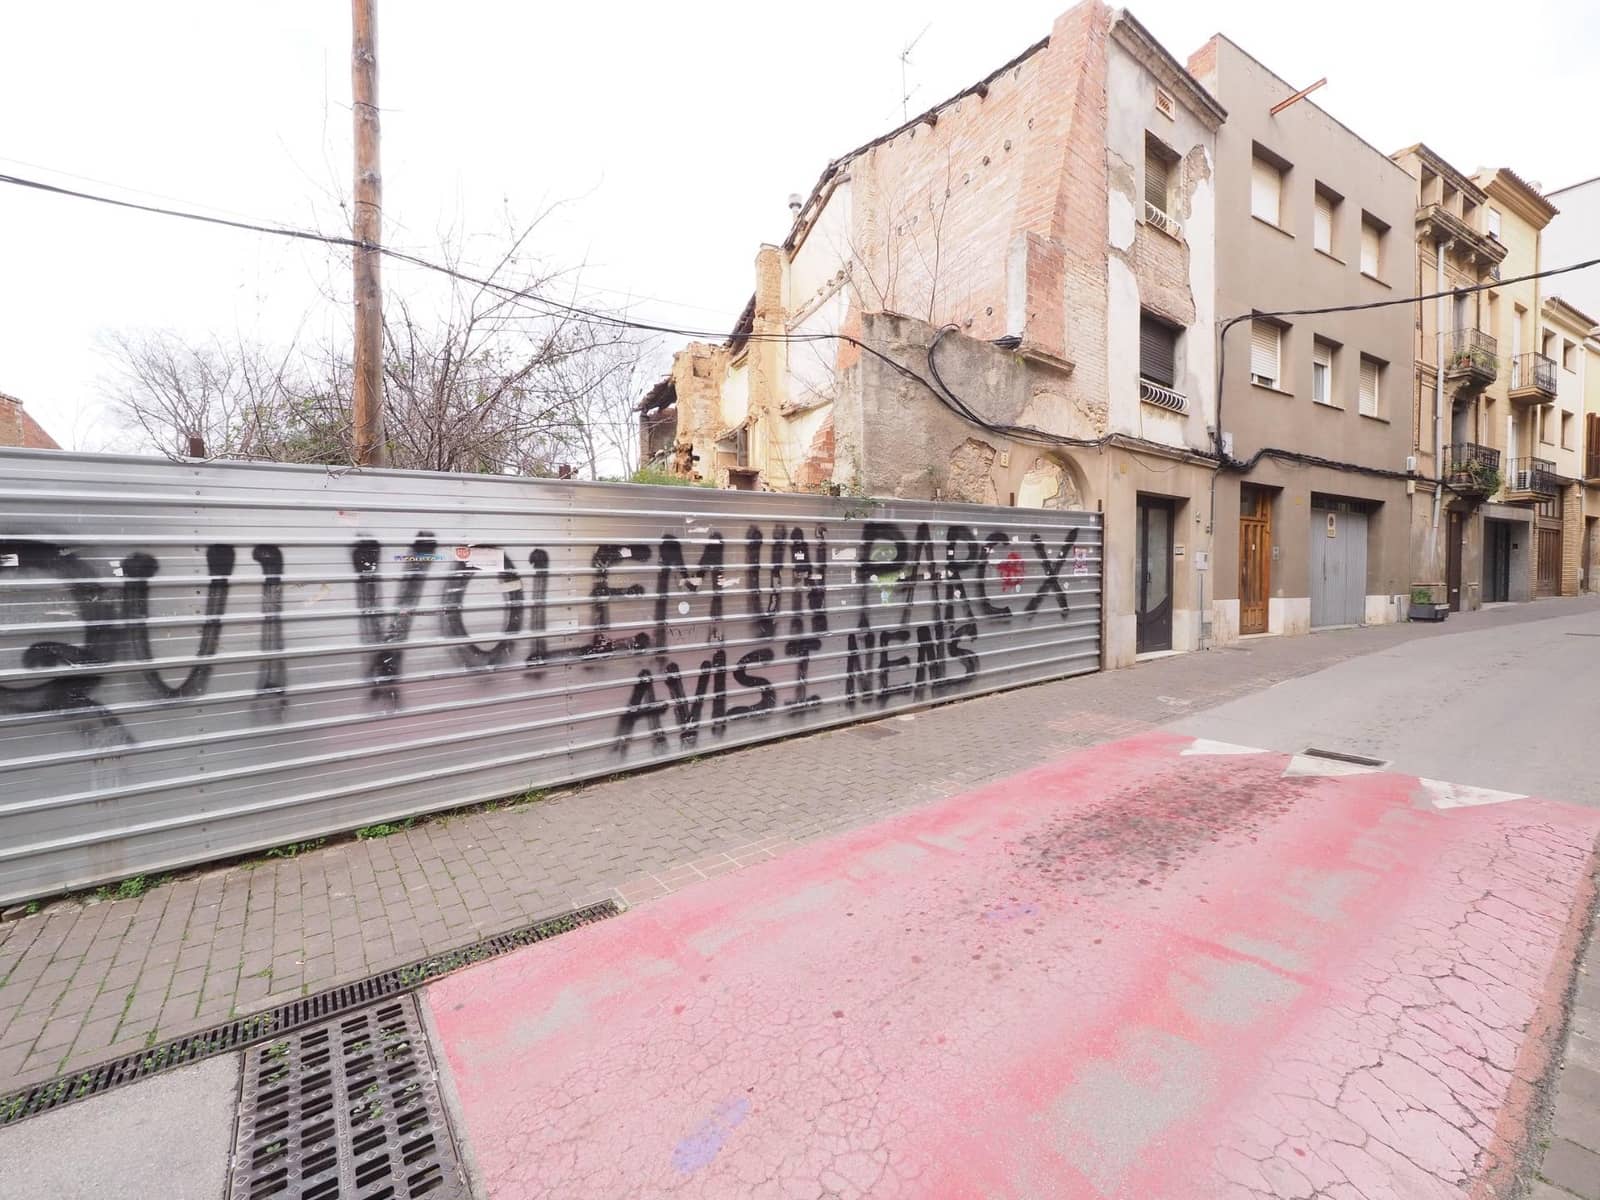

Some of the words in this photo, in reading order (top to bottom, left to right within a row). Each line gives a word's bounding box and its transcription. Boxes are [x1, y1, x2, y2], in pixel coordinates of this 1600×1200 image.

[351, 530, 724, 711] VOLEM
[746, 524, 828, 638] UN
[858, 522, 1013, 626] PARC
[1024, 527, 1080, 620] X
[614, 647, 776, 754] AVIS
[784, 637, 823, 716] I
[846, 620, 980, 706] NENS
